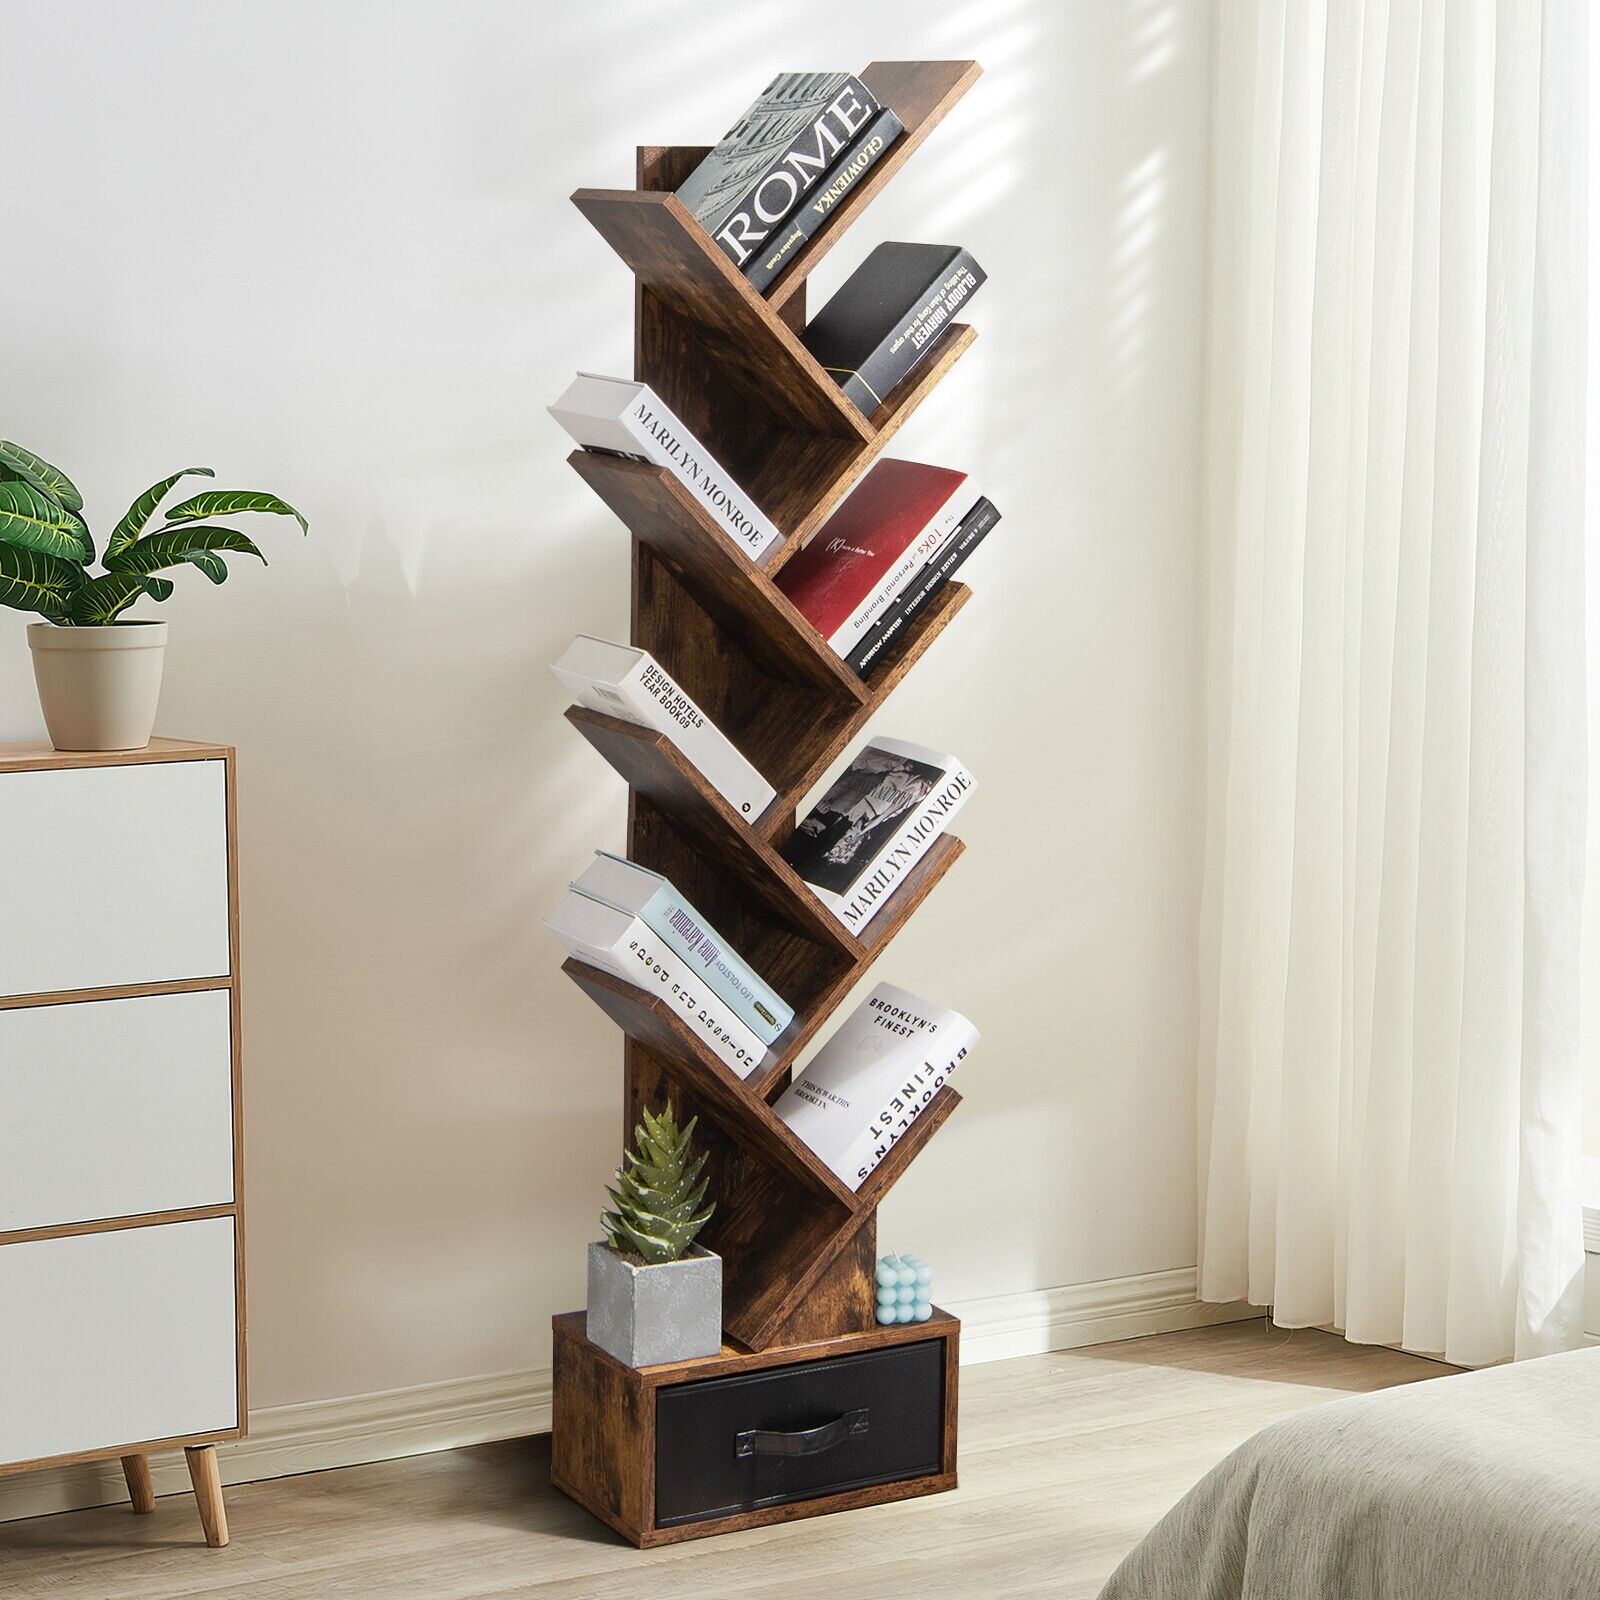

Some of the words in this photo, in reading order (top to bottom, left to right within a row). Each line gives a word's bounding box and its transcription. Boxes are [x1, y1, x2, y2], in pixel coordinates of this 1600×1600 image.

[715, 85, 873, 267] ROME
[944, 272, 977, 312] BLOODY
[911, 305, 948, 350] HARVEST
[633, 404, 704, 481] MARILYN
[698, 475, 764, 547] MONROE
[917, 528, 943, 555] 10Ks
[885, 559, 915, 598] Personal
[853, 594, 885, 629] Branding
[858, 640, 884, 669] ANDREW
[881, 617, 903, 643] MARTIN
[904, 590, 927, 616] INTERIOR
[924, 572, 943, 593] DESIGN
[940, 551, 959, 574] REVIEW
[638, 672, 661, 699] YEAR
[658, 693, 691, 730] BOOK09
[645, 664, 676, 697] DESIGN
[673, 693, 704, 729] HOTELS
[843, 842, 912, 926] MARILYN
[906, 771, 972, 850] MONROE
[668, 908, 704, 952] Karenina
[697, 937, 721, 968] Anna
[715, 960, 744, 992] TOLSTOY
[740, 985, 755, 1001] LEO
[628, 940, 670, 983] speed
[671, 982, 697, 1010] and
[697, 1010, 754, 1068] passion
[869, 998, 938, 1034] BROOKLYN'S
[874, 1015, 915, 1040] FINEST
[802, 1079, 817, 1092] THIS
[814, 1087, 824, 1095] IS
[869, 1061, 936, 1140] FINEST
[857, 1047, 968, 1180] BROOKLYN'S
